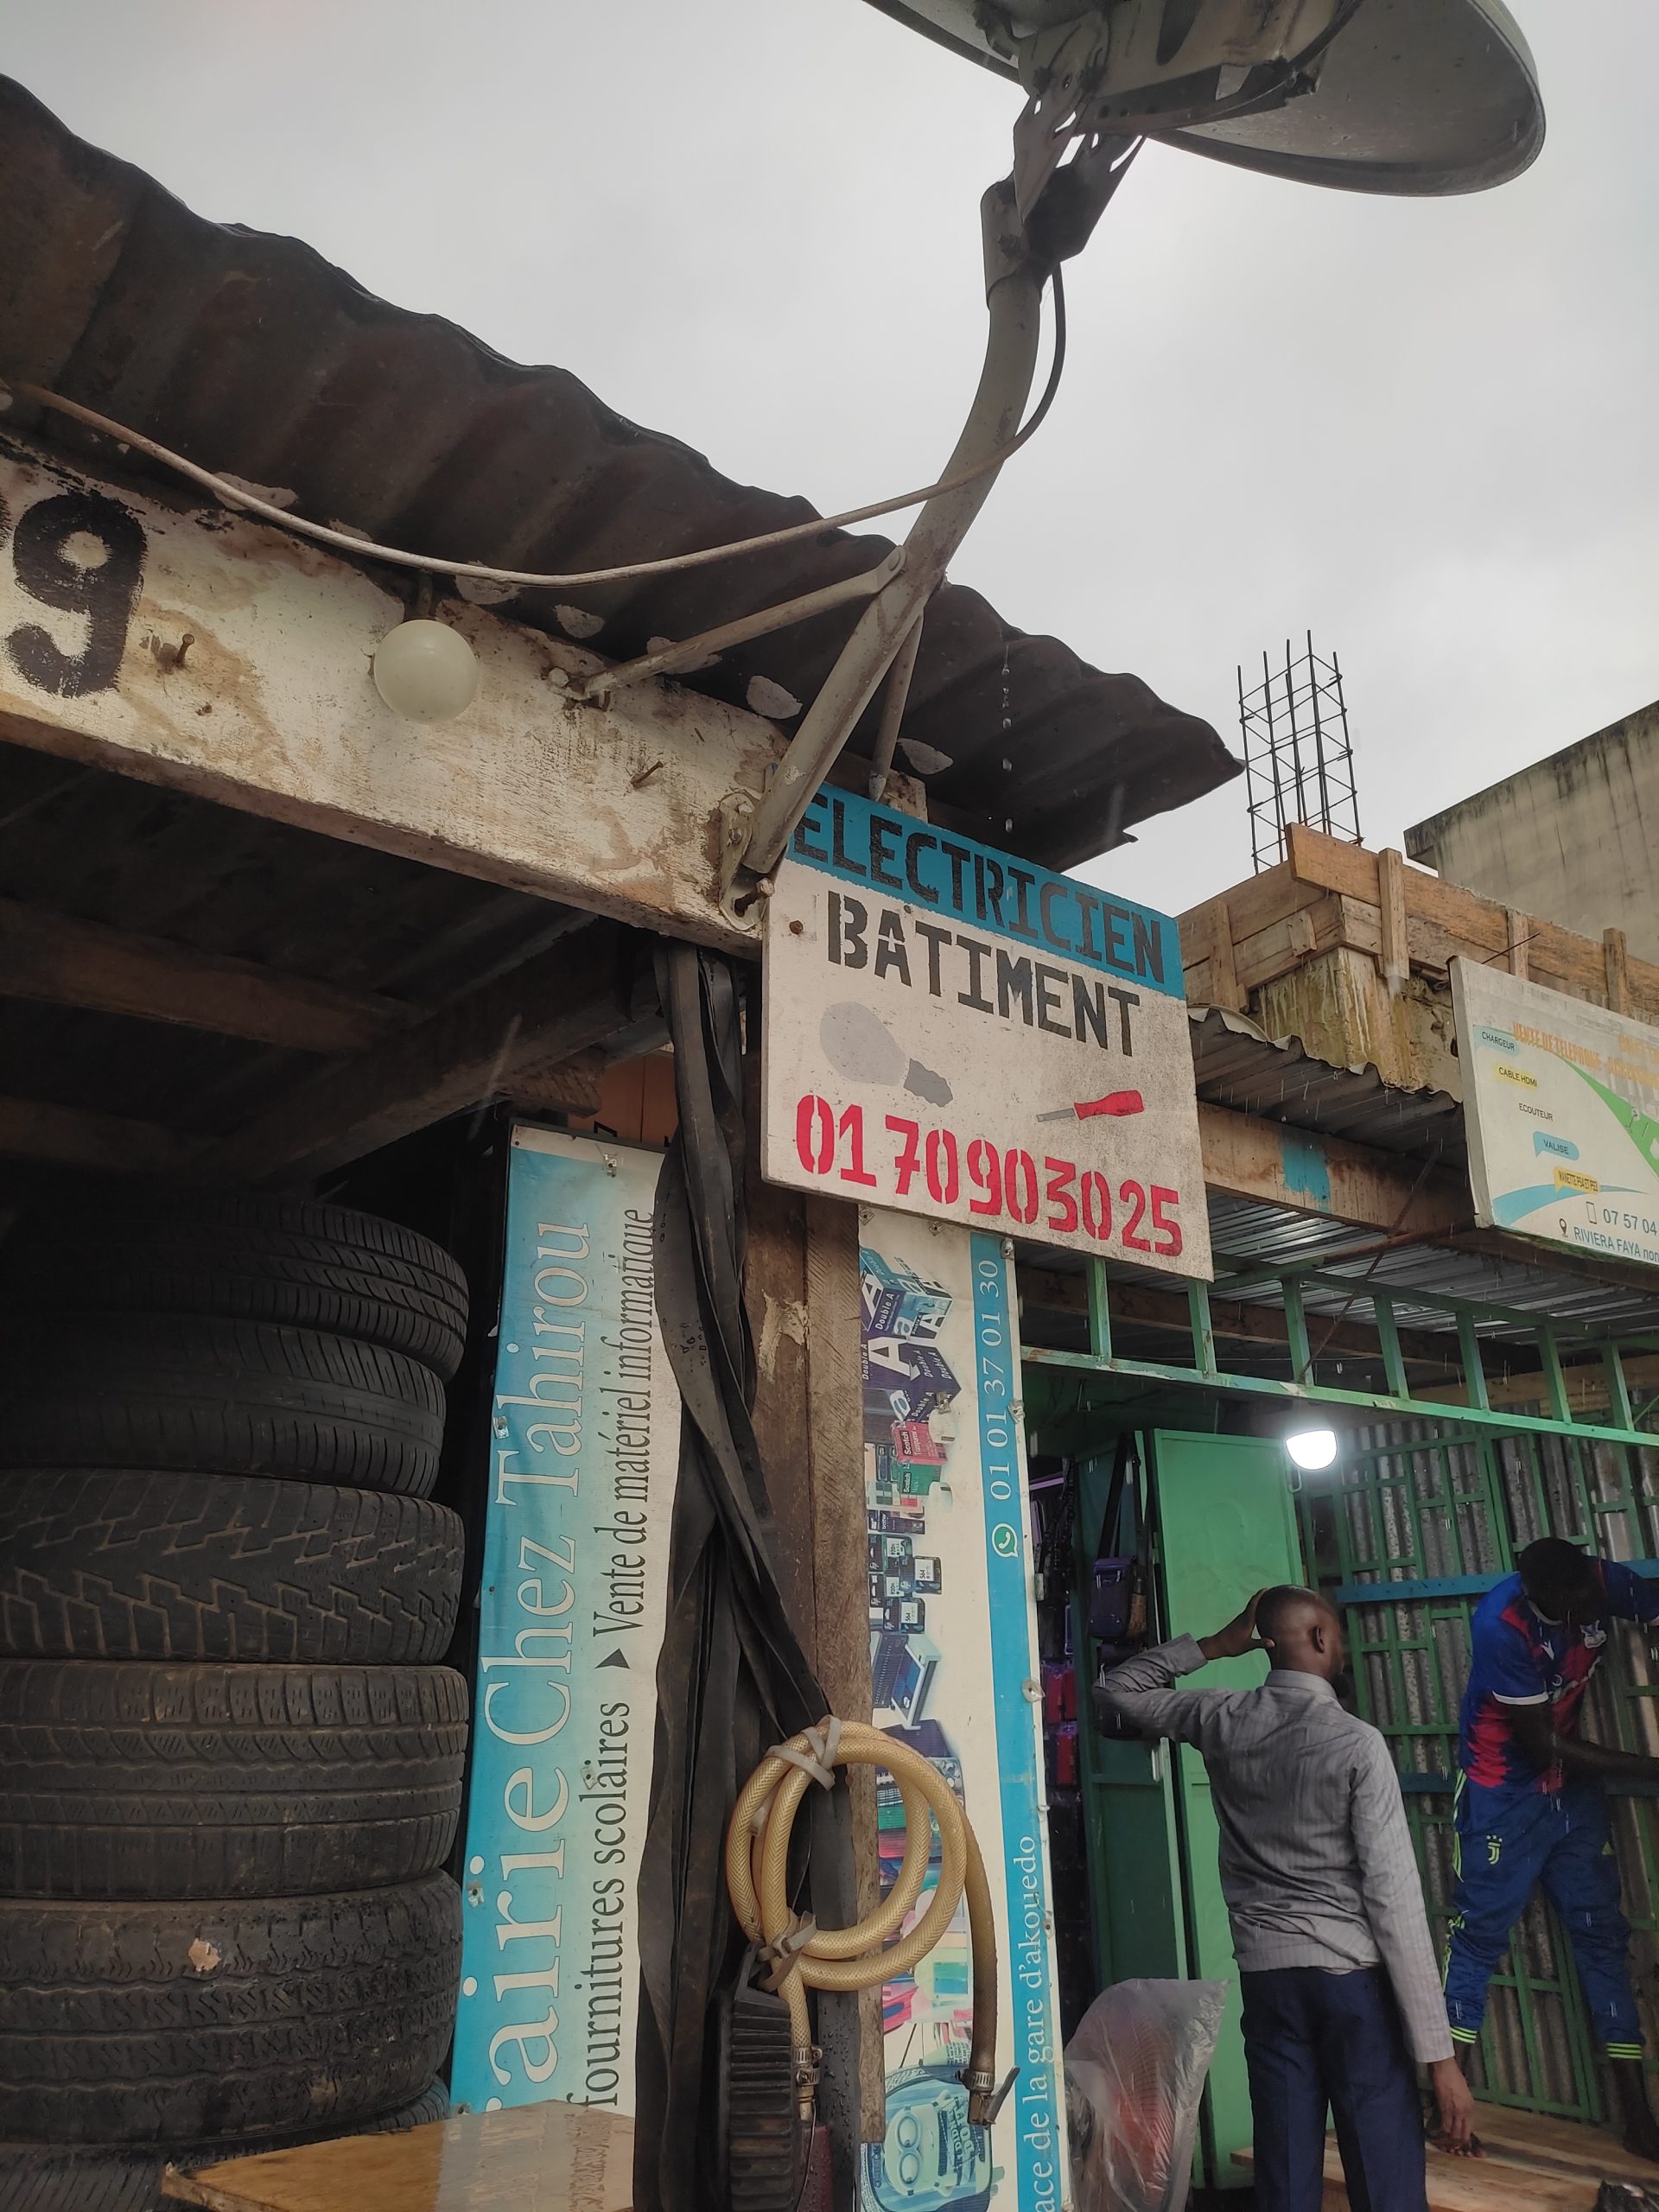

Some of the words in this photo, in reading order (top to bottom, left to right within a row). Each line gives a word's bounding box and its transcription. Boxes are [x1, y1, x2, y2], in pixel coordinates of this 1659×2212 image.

[0, 488, 149, 698] 9
[791, 794, 1165, 984] ELECTRICIEN
[827, 890, 1140, 1057] BATIMENT
[1481, 1031, 1515, 1052] CHARGEUR
[1498, 1066, 1520, 1082] CABLE
[1521, 1073, 1537, 1088] HDMI
[1518, 1103, 1554, 1122] ECOUTEUR
[1543, 1139, 1569, 1154] VALISE
[1573, 1226, 1615, 1250] RIVIERA
[1617, 1238, 1641, 1257] FAYA
[1603, 1208, 1618, 1225] 07
[1624, 1213, 1638, 1230] 57
[1643, 1218, 1657, 1236] 04
[599, 1208, 655, 1383] informatique
[978, 1259, 1000, 1300] 30
[875, 1302, 892, 1329] Double
[980, 1310, 1002, 1347] 01
[495, 1221, 591, 1507] Tahirou
[868, 1337, 911, 1376] A
[917, 1357, 933, 1377] Double
[935, 1358, 952, 1379] Double
[983, 1357, 1007, 1399] 37
[912, 1398, 930, 1417] Double
[597, 1385, 652, 1504] matériel
[901, 1431, 912, 1455] Scotch
[985, 1408, 1008, 1451] 01
[990, 1461, 1012, 1502] 01
[593, 1510, 648, 1545] de
[593, 1558, 645, 1637] Vente
[480, 1533, 577, 1746] Chez
[579, 1701, 630, 1864] scolaires
[462, 1766, 569, 2113] airie
[567, 1878, 625, 2109] fournitures
[1026, 1998, 1055, 2063] gare
[1021, 2071, 1049, 2103] la
[960, 2127, 975, 2154] DO
[1022, 2110, 1051, 2145] de
